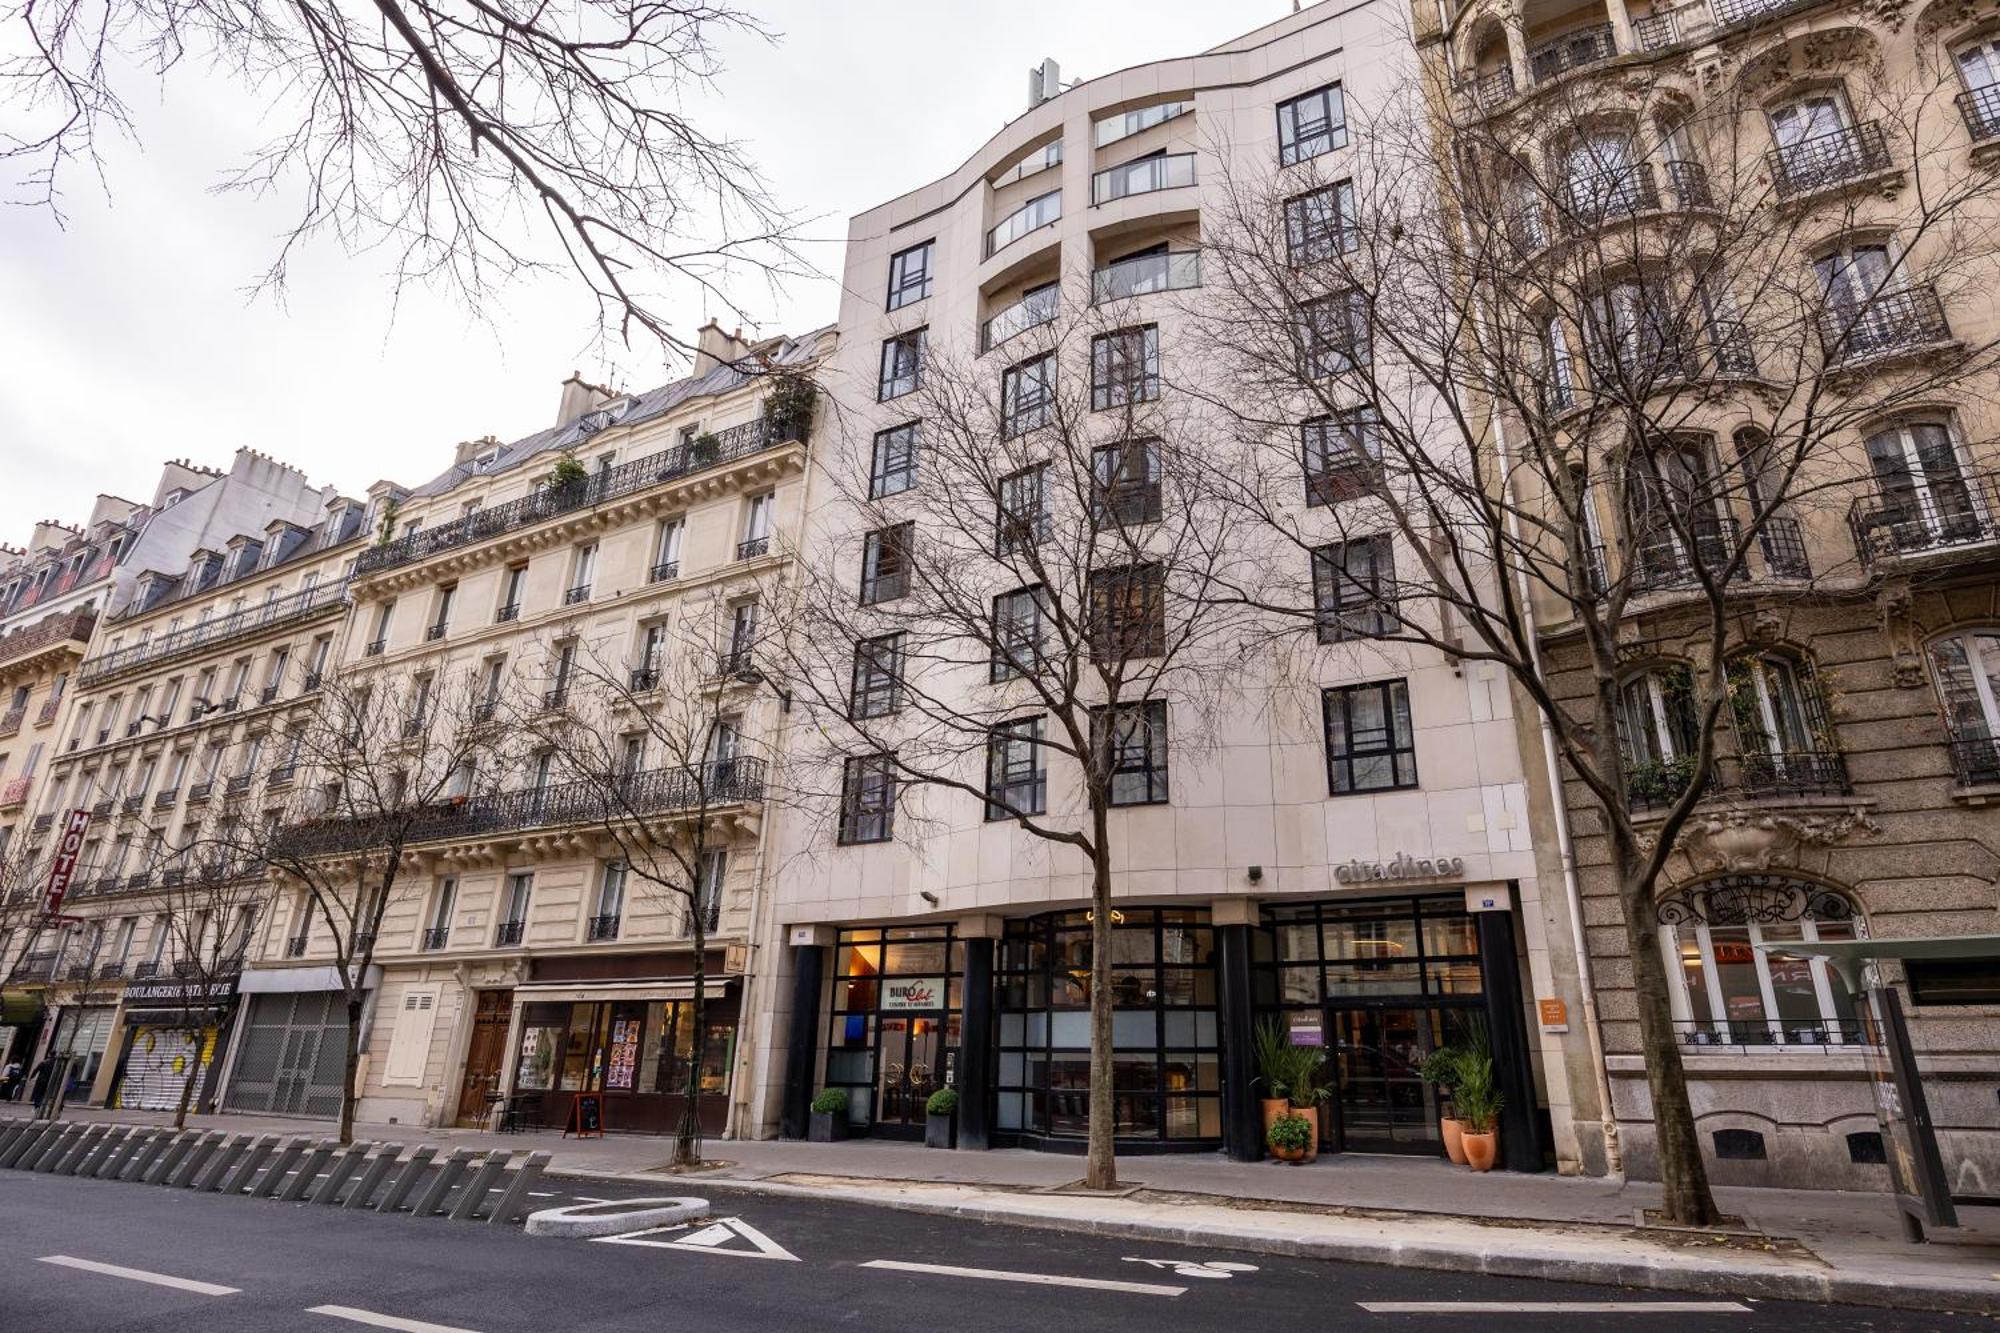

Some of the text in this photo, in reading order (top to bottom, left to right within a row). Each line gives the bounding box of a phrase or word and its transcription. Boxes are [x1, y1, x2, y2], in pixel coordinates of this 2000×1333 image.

[42, 813, 89, 913] HOTEL
[1335, 852, 1464, 885] citadines
[890, 986, 916, 997] BURO
